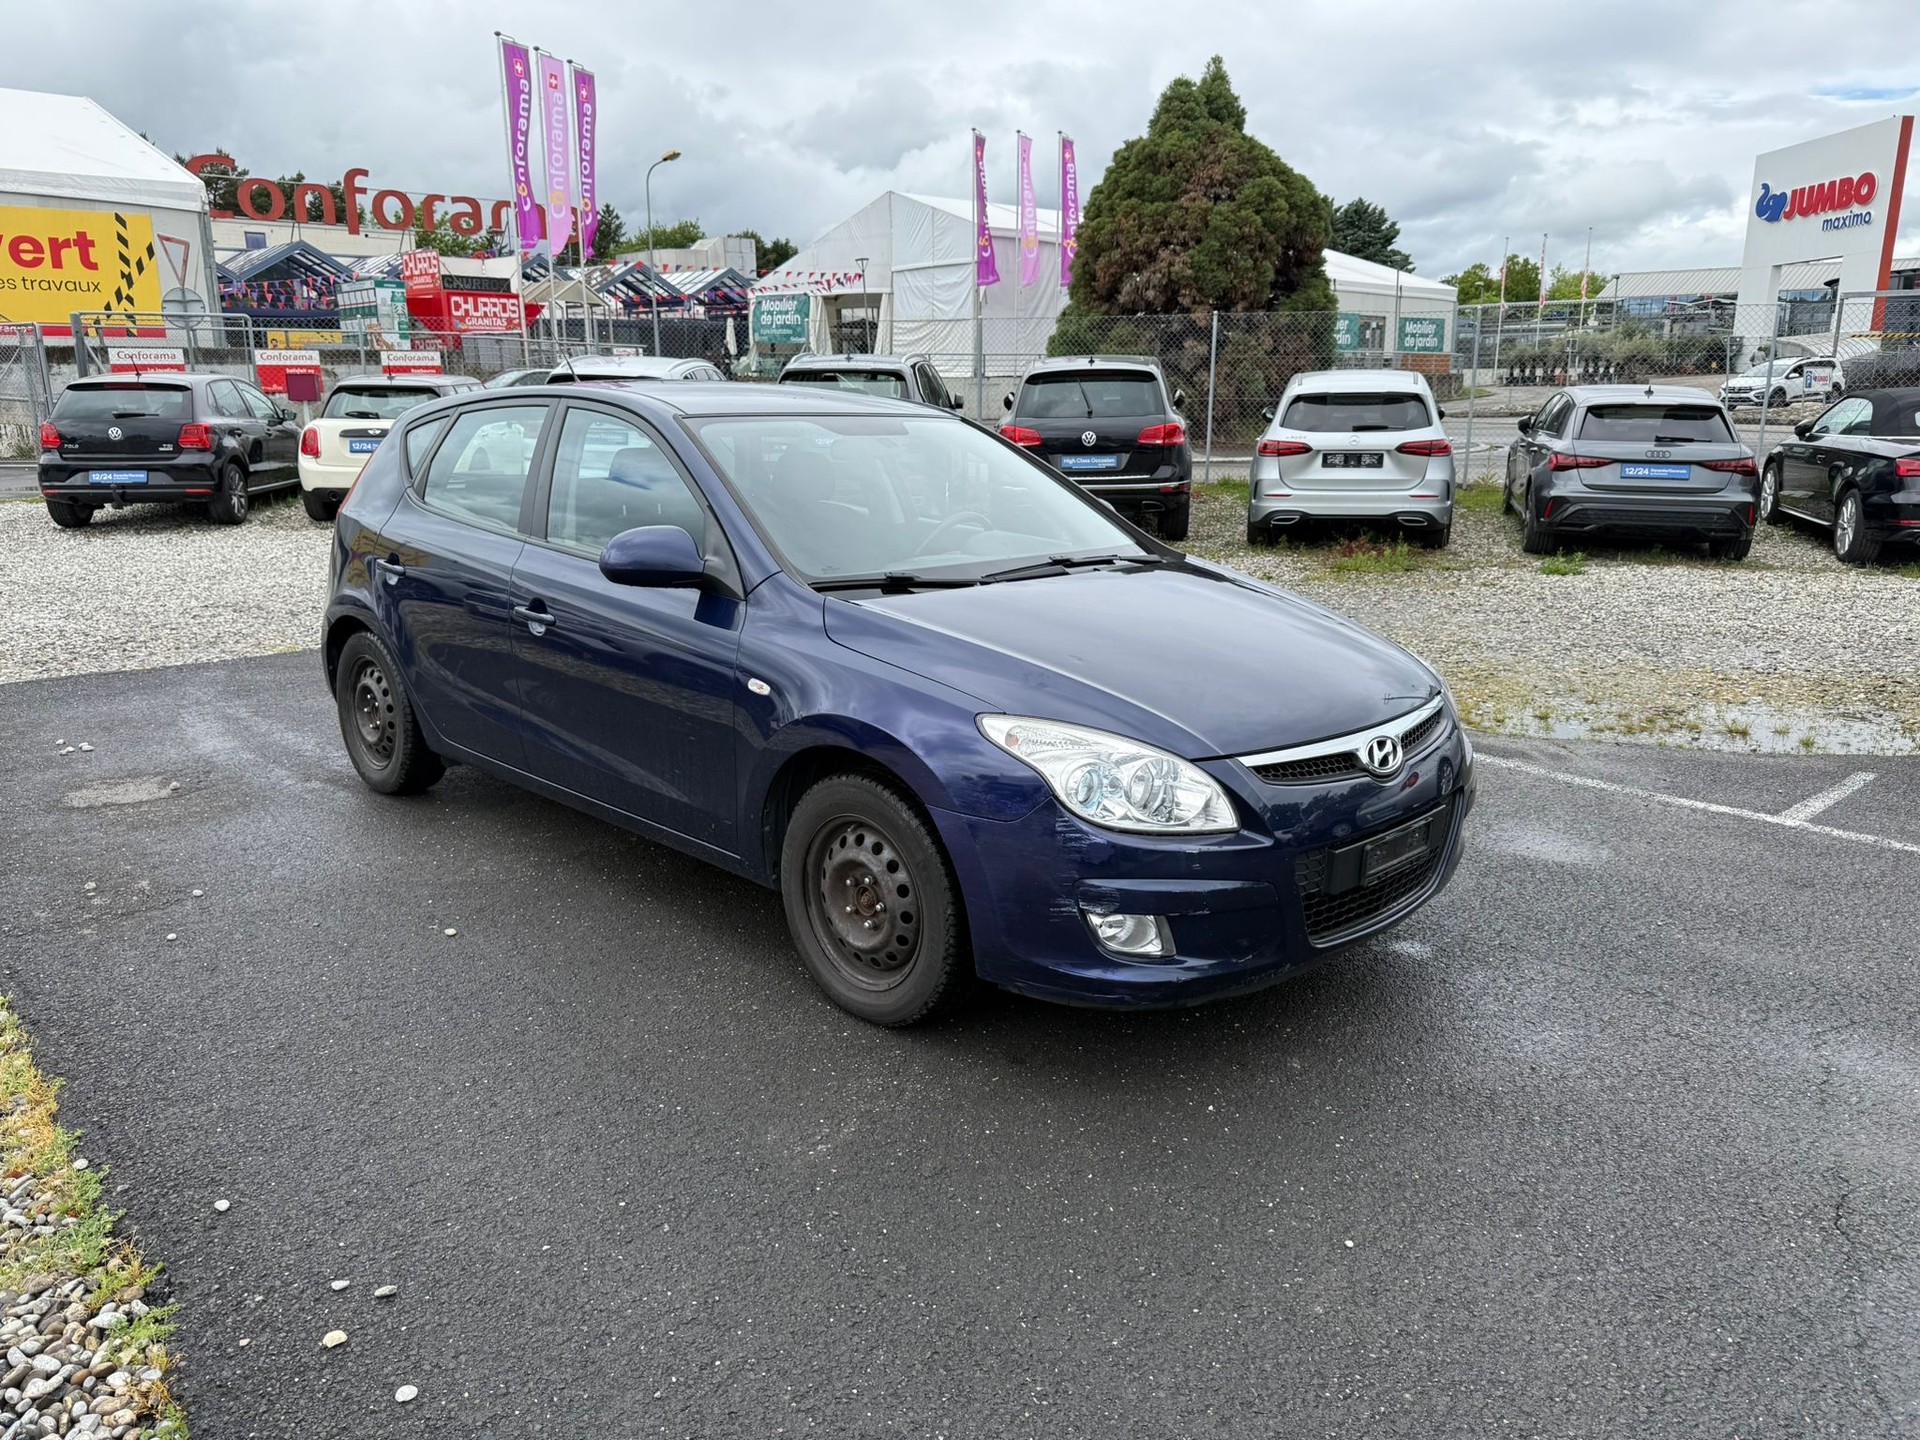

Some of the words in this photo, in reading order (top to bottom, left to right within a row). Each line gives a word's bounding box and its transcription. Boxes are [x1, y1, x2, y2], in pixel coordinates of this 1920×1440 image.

[1782, 172, 1877, 220] JUMBO
[1821, 210, 1872, 231] maximo
[0, 230, 99, 270] ert
[21, 276, 102, 293] travaux
[451, 296, 519, 318] CHURROS
[761, 298, 797, 311] Mobilier
[465, 316, 507, 327] GRANITAS
[761, 312, 772, 325] de
[772, 311, 801, 328] jardin
[1405, 321, 1437, 335] Mobilier
[1404, 335, 1415, 347] de
[1414, 334, 1438, 351] jardin
[117, 350, 177, 360] Conforama
[260, 352, 313, 361] Conforama
[388, 353, 435, 362] Conforama
[352, 442, 371, 450] 12/24
[1624, 467, 1649, 475] 12/24
